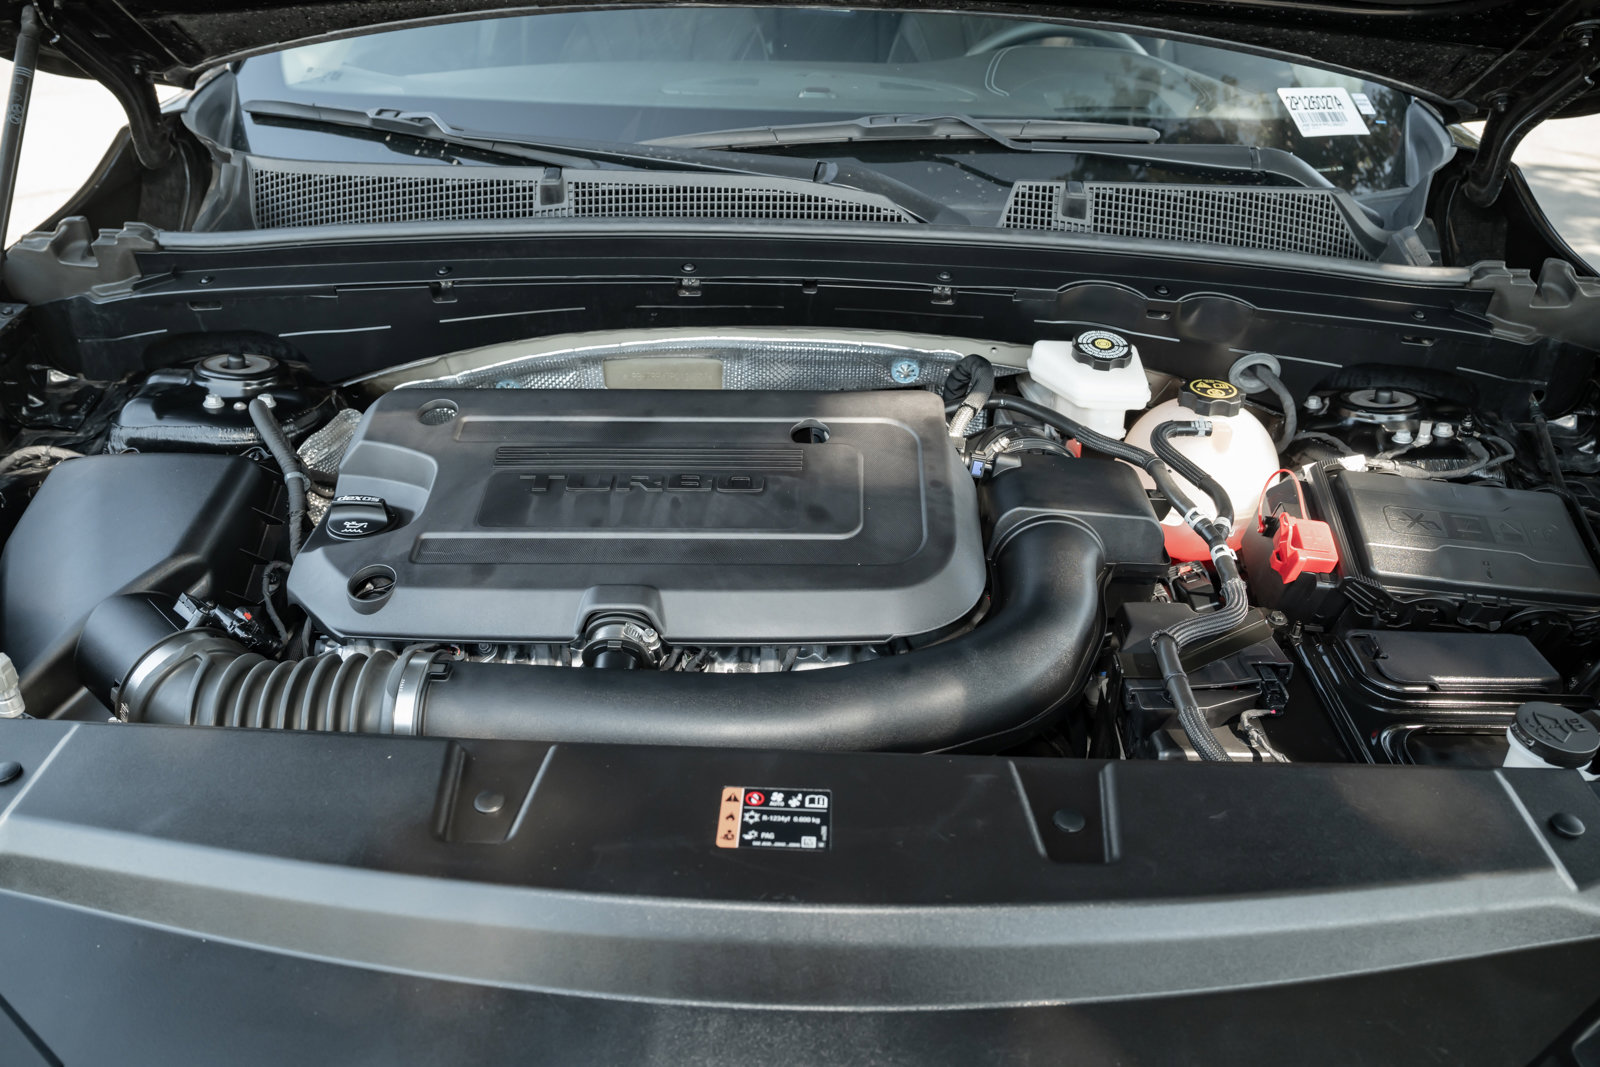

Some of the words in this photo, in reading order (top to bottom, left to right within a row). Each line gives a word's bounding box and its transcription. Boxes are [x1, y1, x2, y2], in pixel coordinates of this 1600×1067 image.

[1286, 95, 1344, 110] 2P126027A
[520, 474, 765, 493] TURBO
[812, 816, 821, 824] kg
